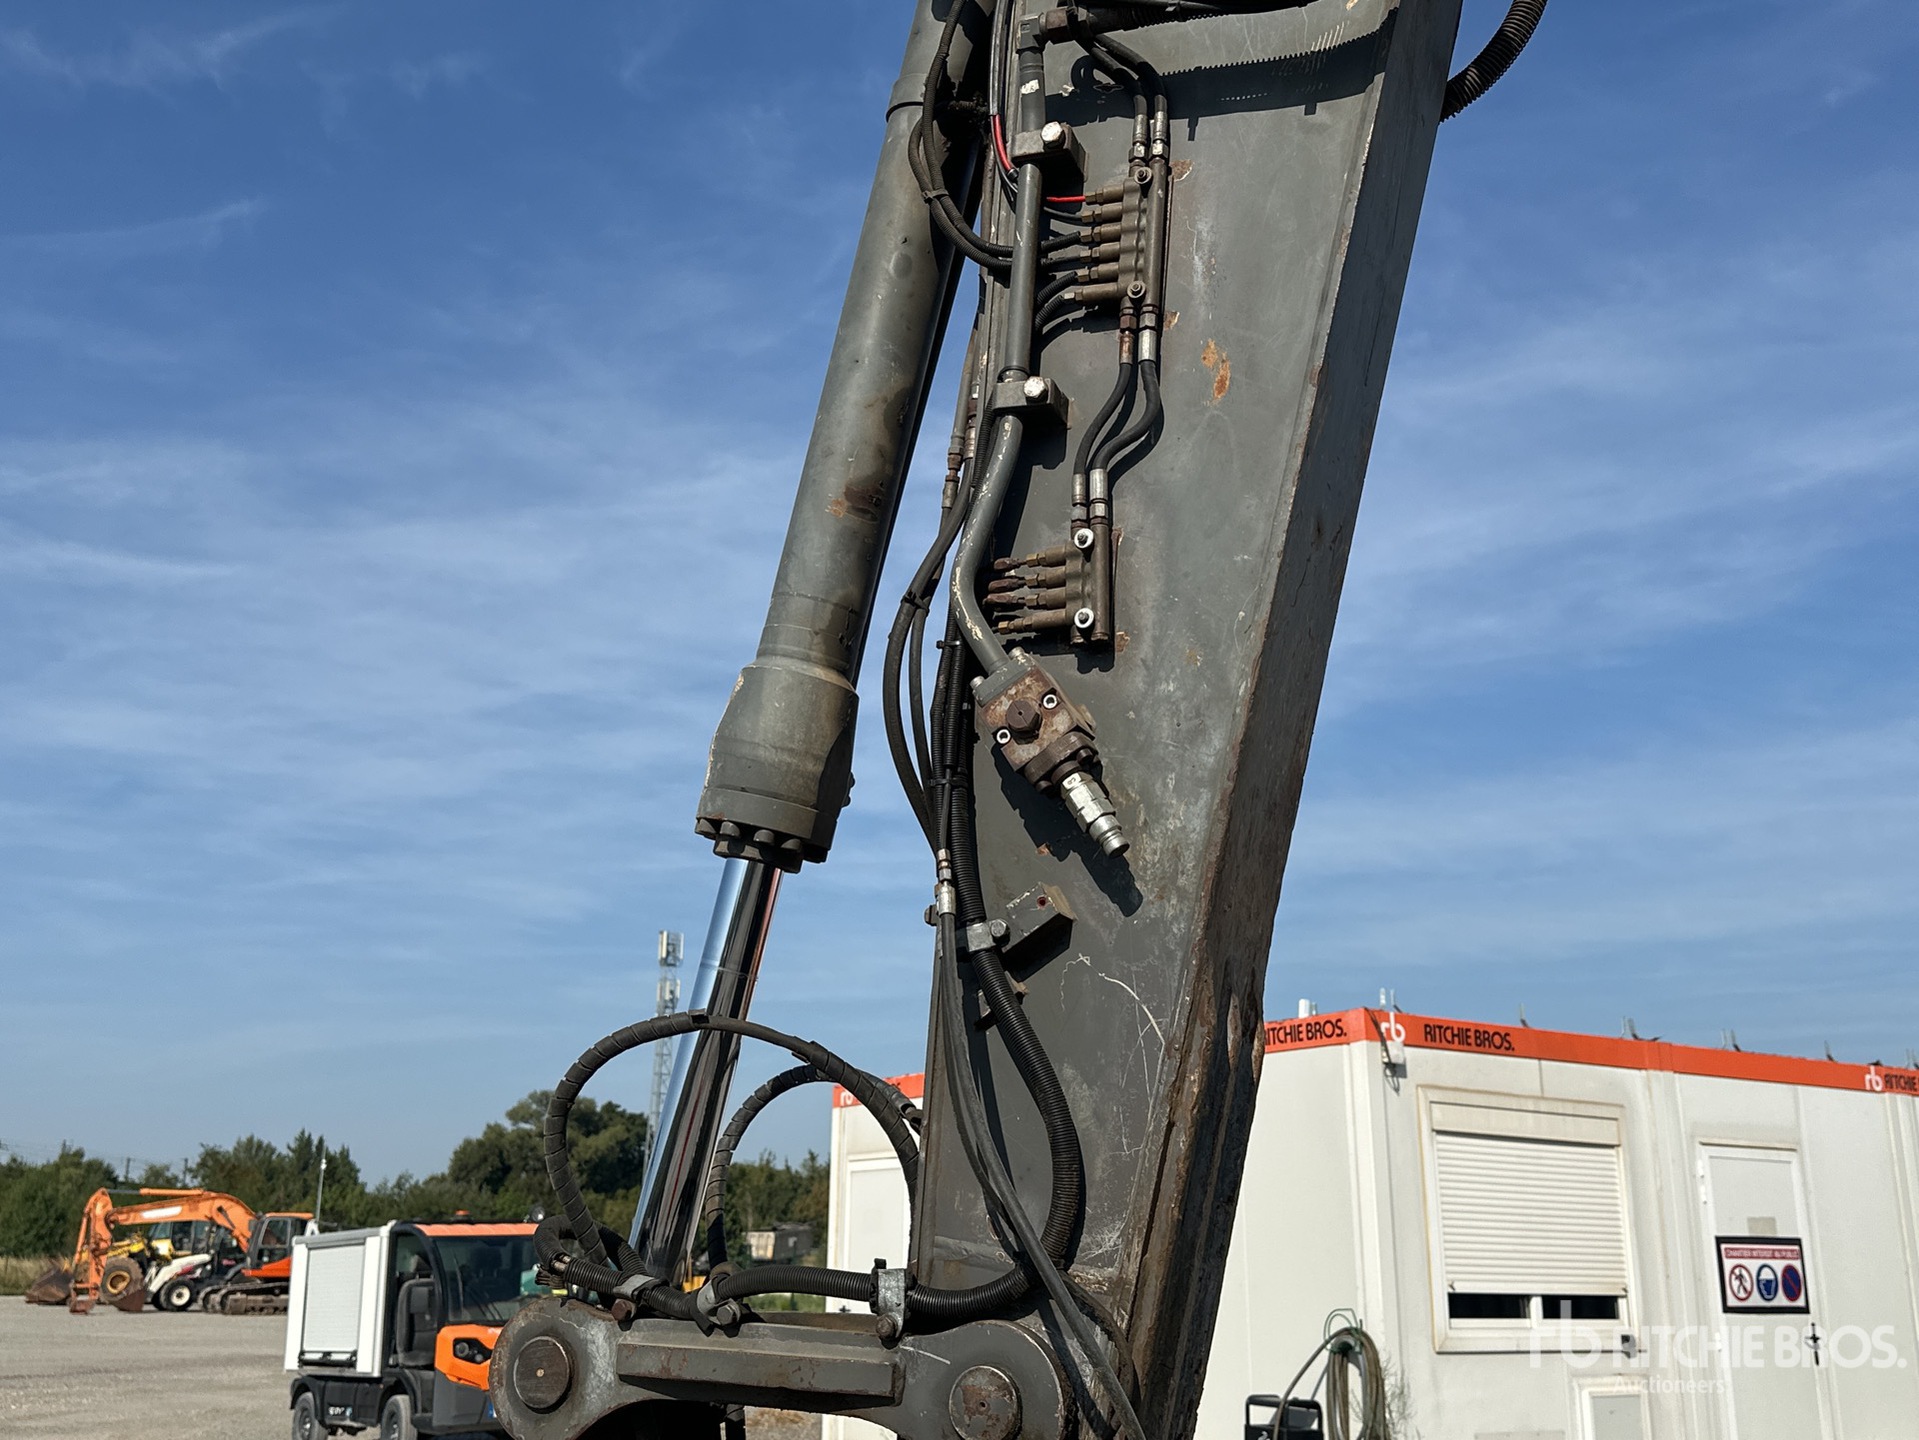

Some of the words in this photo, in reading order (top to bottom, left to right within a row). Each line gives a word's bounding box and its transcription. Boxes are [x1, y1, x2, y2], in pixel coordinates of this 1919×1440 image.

[1305, 1018, 1347, 1040] BROS.
[1424, 1024, 1472, 1046] RITCHIE
[1474, 1029, 1516, 1051] BROS.
